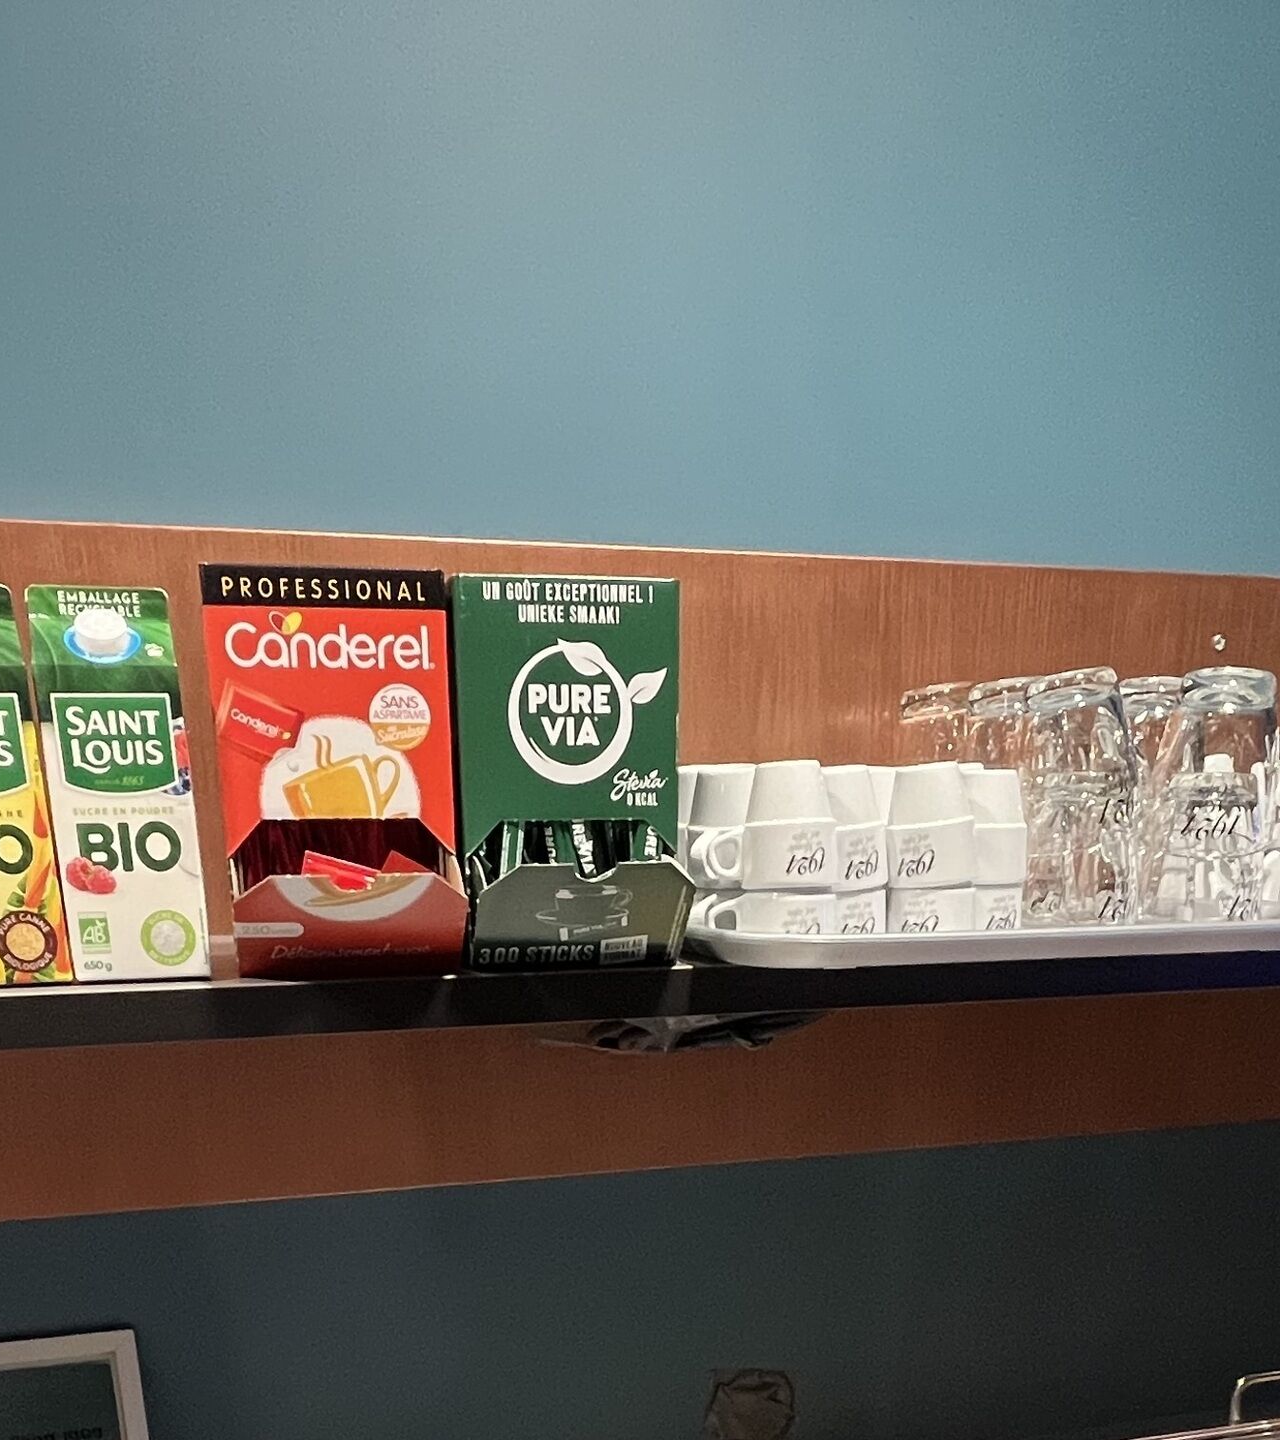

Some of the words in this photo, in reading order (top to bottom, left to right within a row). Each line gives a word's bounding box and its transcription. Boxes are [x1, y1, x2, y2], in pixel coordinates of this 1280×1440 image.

[56, 591, 140, 604] EMBALLAGE
[221, 576, 426, 602] PROFESSIONAL
[482, 581, 500, 600] UN
[506, 579, 541, 601] GOÛT
[545, 583, 643, 603] EXCEPTIONNEL
[518, 605, 564, 623] UNIEKE
[570, 606, 620, 624] SMAAK!
[224, 620, 431, 670] Canderel
[380, 695, 419, 709] SANS
[527, 684, 612, 715] PURE
[66, 706, 160, 736] SAINT
[540, 716, 599, 747] VIA
[72, 738, 165, 774] LOUIS
[610, 768, 666, 801] Stevia
[76, 821, 182, 872] BIO
[786, 846, 825, 877] 1921
[845, 850, 879, 880] 1921
[897, 848, 935, 877] 1921
[479, 947, 519, 965] 300
[525, 944, 595, 964] STICKS
